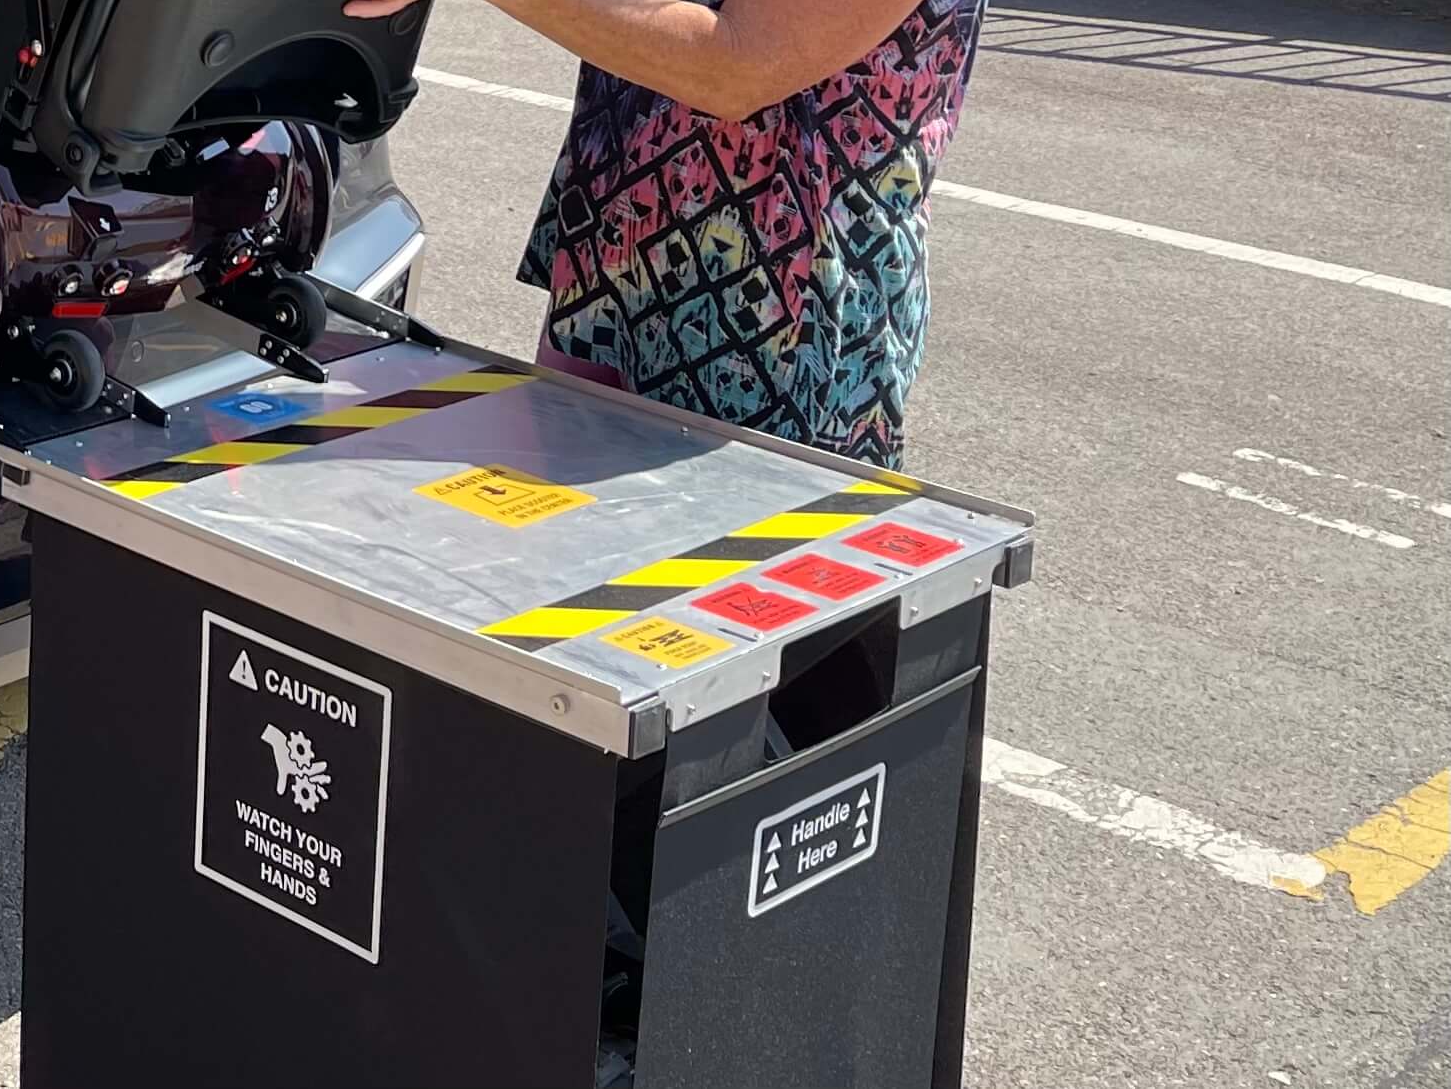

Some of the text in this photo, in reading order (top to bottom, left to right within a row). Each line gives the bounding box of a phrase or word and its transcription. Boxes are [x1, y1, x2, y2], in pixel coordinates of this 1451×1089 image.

[445, 469, 507, 491] CAUTION
[264, 668, 357, 728] CAUTION
[236, 799, 342, 868] WATCH YOUR
[791, 801, 851, 847] Handle
[244, 828, 331, 889] FINGERS &
[797, 839, 838, 874] Here
[260, 862, 317, 906] HANDS
